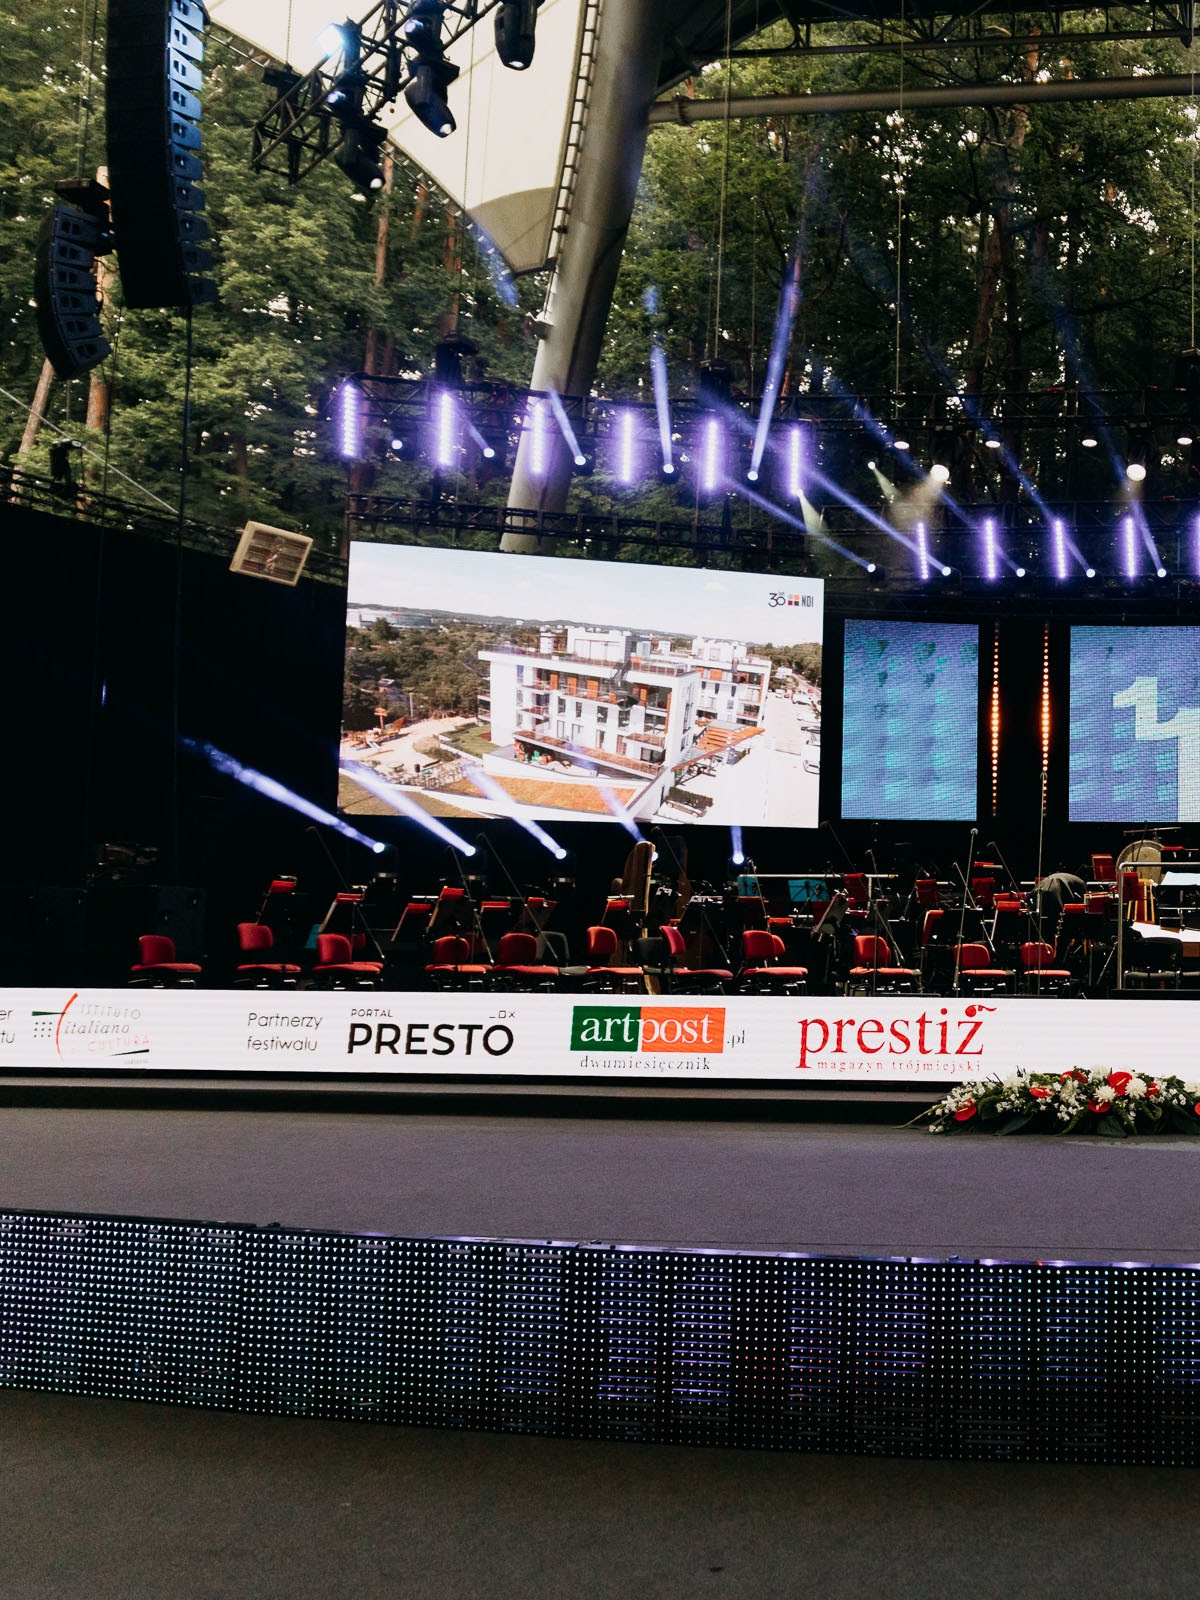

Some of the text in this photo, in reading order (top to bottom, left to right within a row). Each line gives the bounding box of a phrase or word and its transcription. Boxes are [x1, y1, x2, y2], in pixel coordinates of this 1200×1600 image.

[768, 592, 814, 608] 30 NDI
[247, 1012, 323, 1030] Partnerzy
[350, 1008, 393, 1018] PORTAL
[64, 1020, 130, 1035] italiano
[580, 1013, 713, 1052] artpost
[246, 1036, 318, 1052] festiwalu
[347, 1023, 514, 1056] PRESTO
[580, 1055, 711, 1073] dwumiesięcznik
[817, 1059, 982, 1074] magazyn trójmiejski
